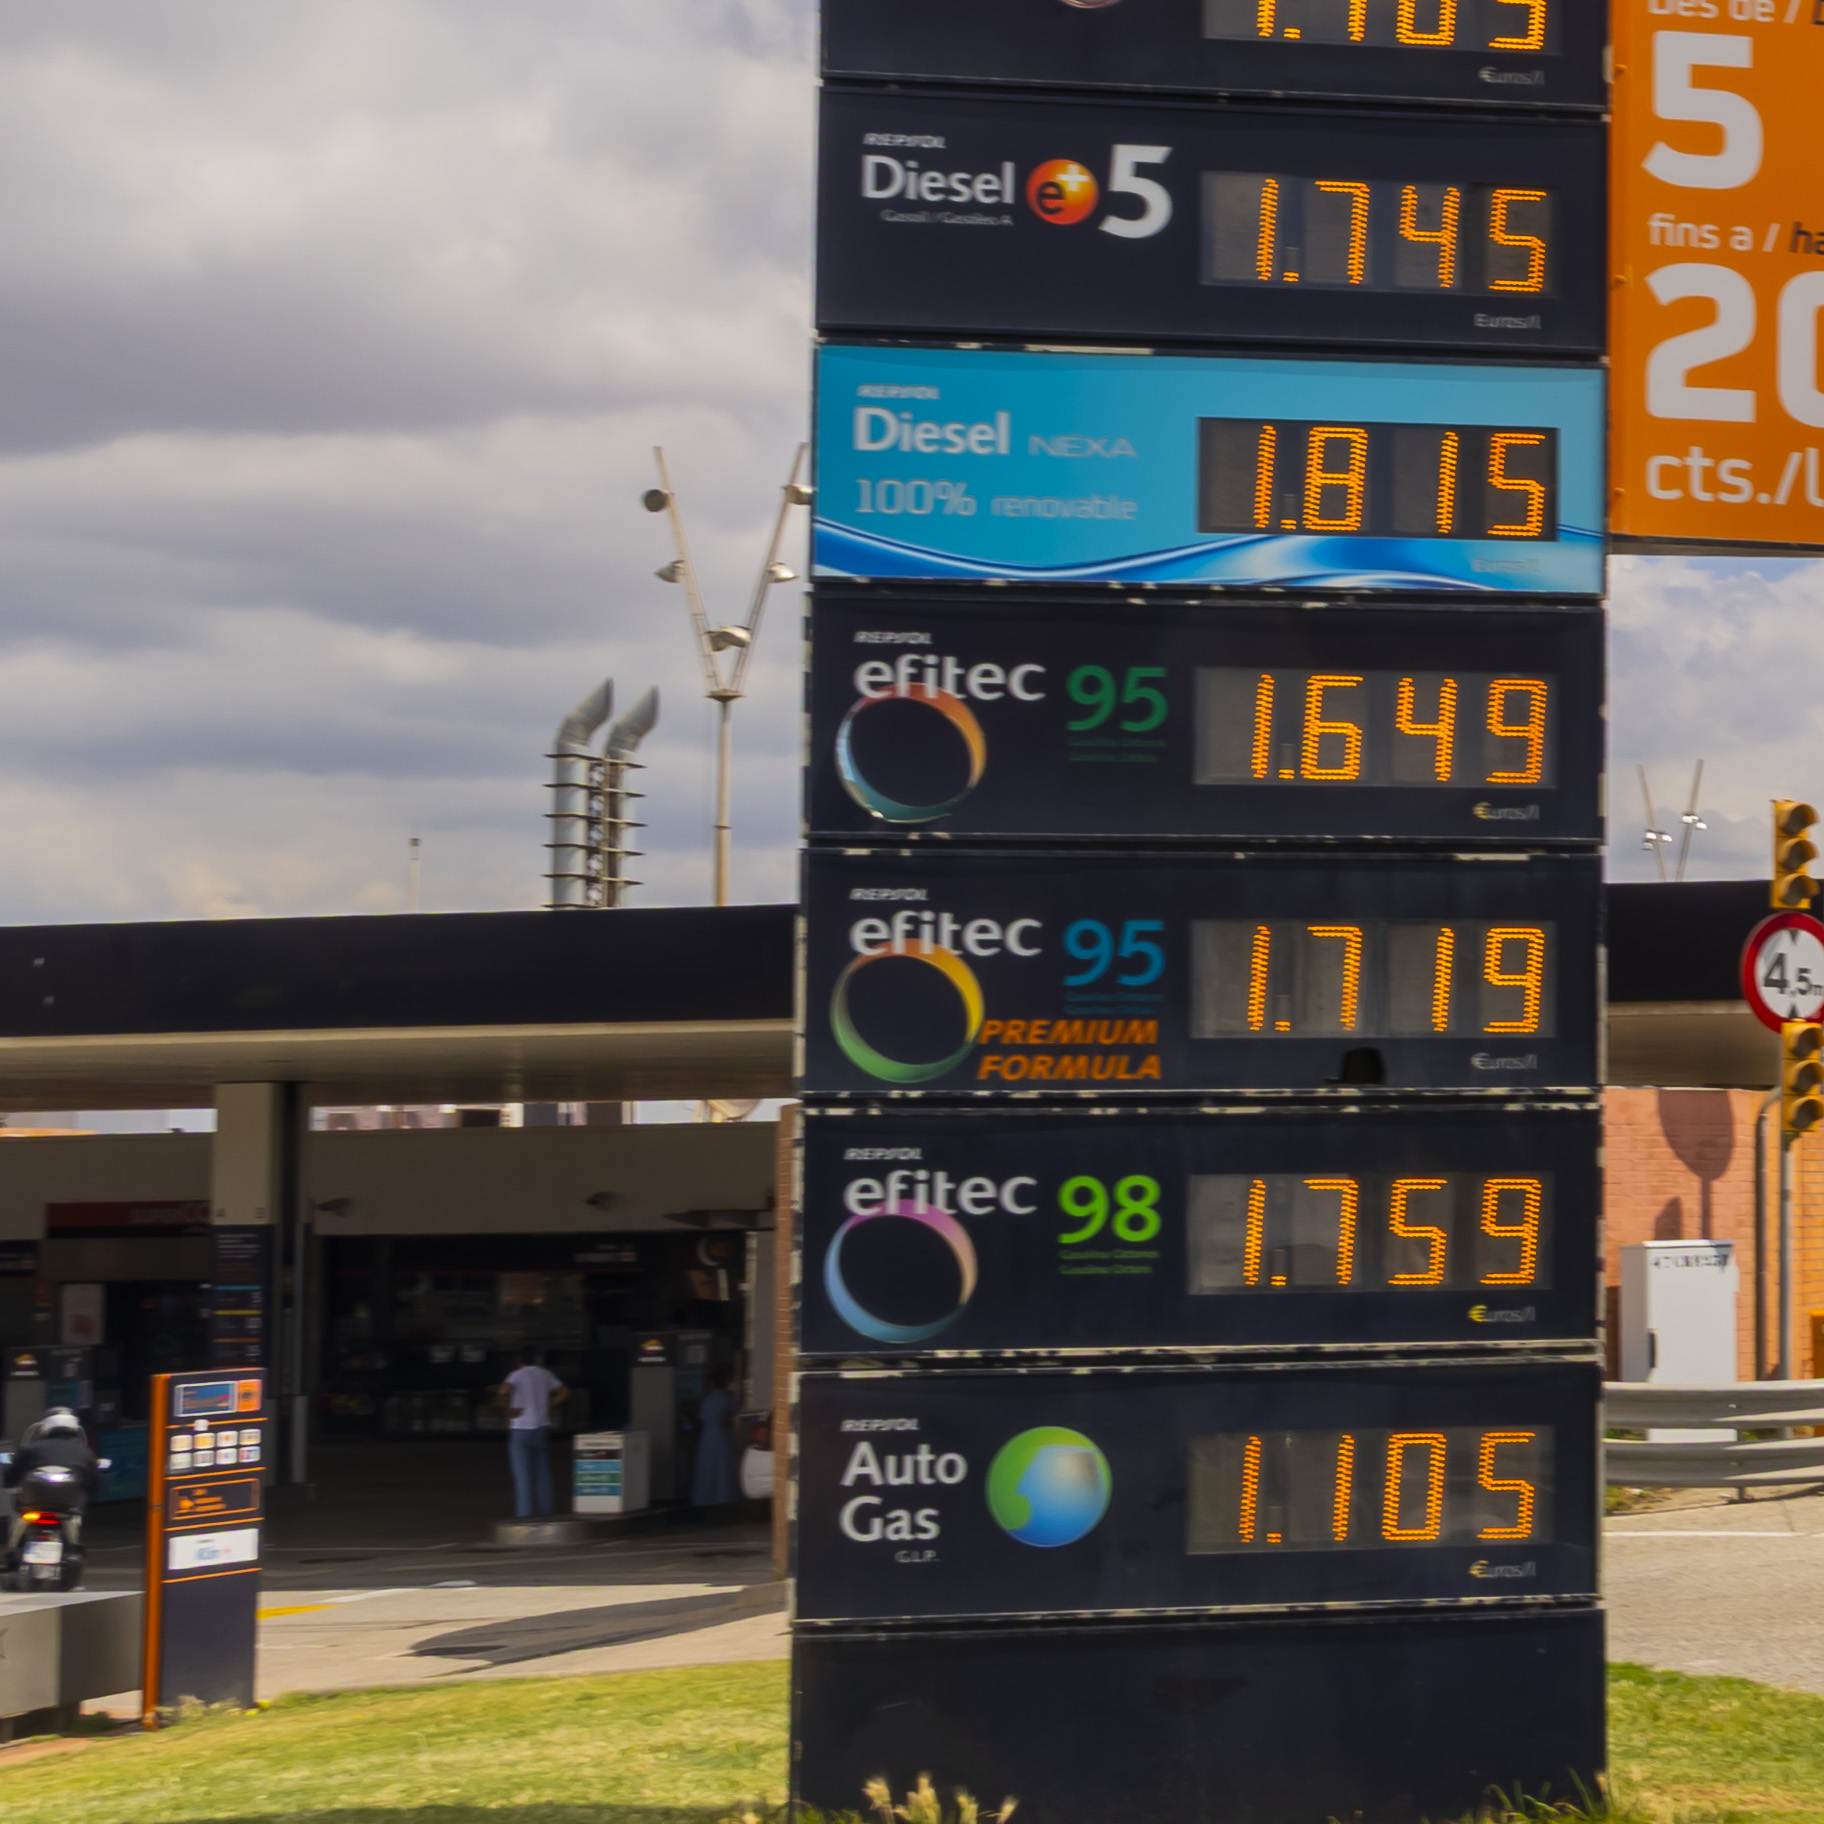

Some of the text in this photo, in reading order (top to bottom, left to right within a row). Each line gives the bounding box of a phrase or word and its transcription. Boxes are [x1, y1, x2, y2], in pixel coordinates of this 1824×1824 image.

[1641, 29, 1764, 190] 5
[861, 154, 1016, 205] Diesel
[1098, 144, 1173, 238] 5
[1255, 179, 1547, 293] 1.745
[1647, 213, 1720, 249] fins
[1729, 225, 1753, 251] a
[1762, 223, 1781, 253] /
[853, 405, 1138, 457] Diesel NEXA
[855, 478, 1138, 520] 100% renovable
[1252, 424, 1547, 538] 1.815
[852, 652, 1169, 732] efitec 95
[1251, 674, 1549, 784] 1.649
[849, 910, 1166, 987] efitec 95
[1247, 926, 1546, 1032] 1.719
[977, 1019, 1160, 1045] PREMIUM
[977, 1054, 1163, 1081] FORMULA
[843, 1170, 1163, 1244] efitec 98
[1244, 1179, 1542, 1286] 1.759
[840, 1442, 969, 1487] Auto
[1239, 1433, 1538, 1543] 1.105
[838, 1496, 940, 1542] Gas
